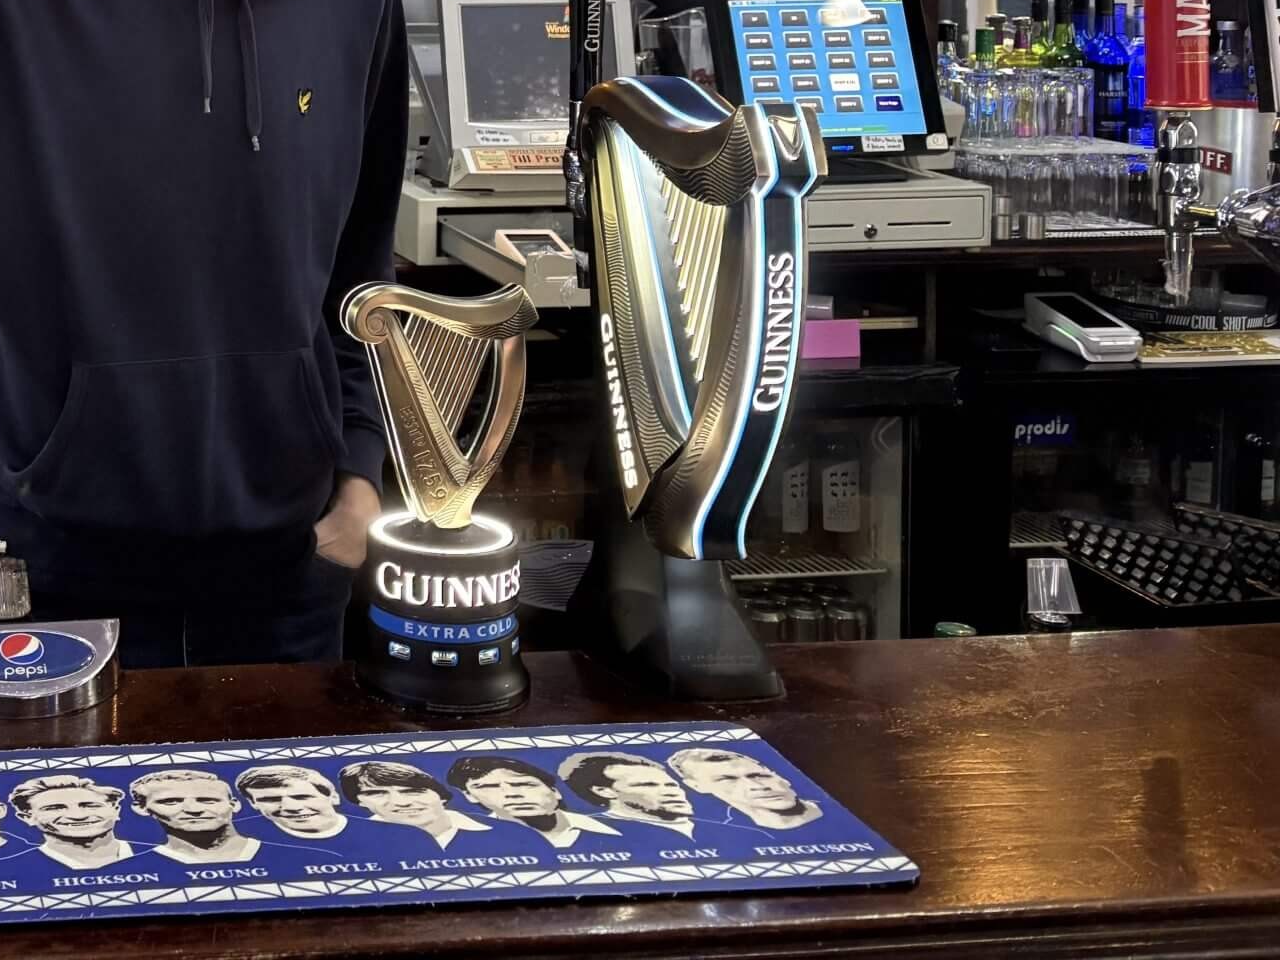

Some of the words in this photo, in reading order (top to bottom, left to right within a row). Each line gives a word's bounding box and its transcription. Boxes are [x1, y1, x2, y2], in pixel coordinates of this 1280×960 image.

[511, 154, 531, 164] Till
[753, 251, 794, 413] GUINNESS
[1191, 316, 1218, 330] COOL
[1223, 316, 1248, 331] SHOT
[601, 313, 638, 489] GUINNESS
[1015, 417, 1069, 442] prodis
[412, 449, 448, 500] 1759
[403, 622, 470, 639] EXTRA
[477, 616, 512, 638] COLD
[4, 663, 47, 680] pepsi
[53, 873, 160, 887] HICKSON
[186, 867, 270, 880] YOUNG
[304, 861, 383, 874] ROYLE
[398, 855, 538, 871] LATCHFORD
[557, 851, 631, 865] SHARP
[658, 848, 720, 861] GRAY
[753, 842, 874, 857] FERGUSON
